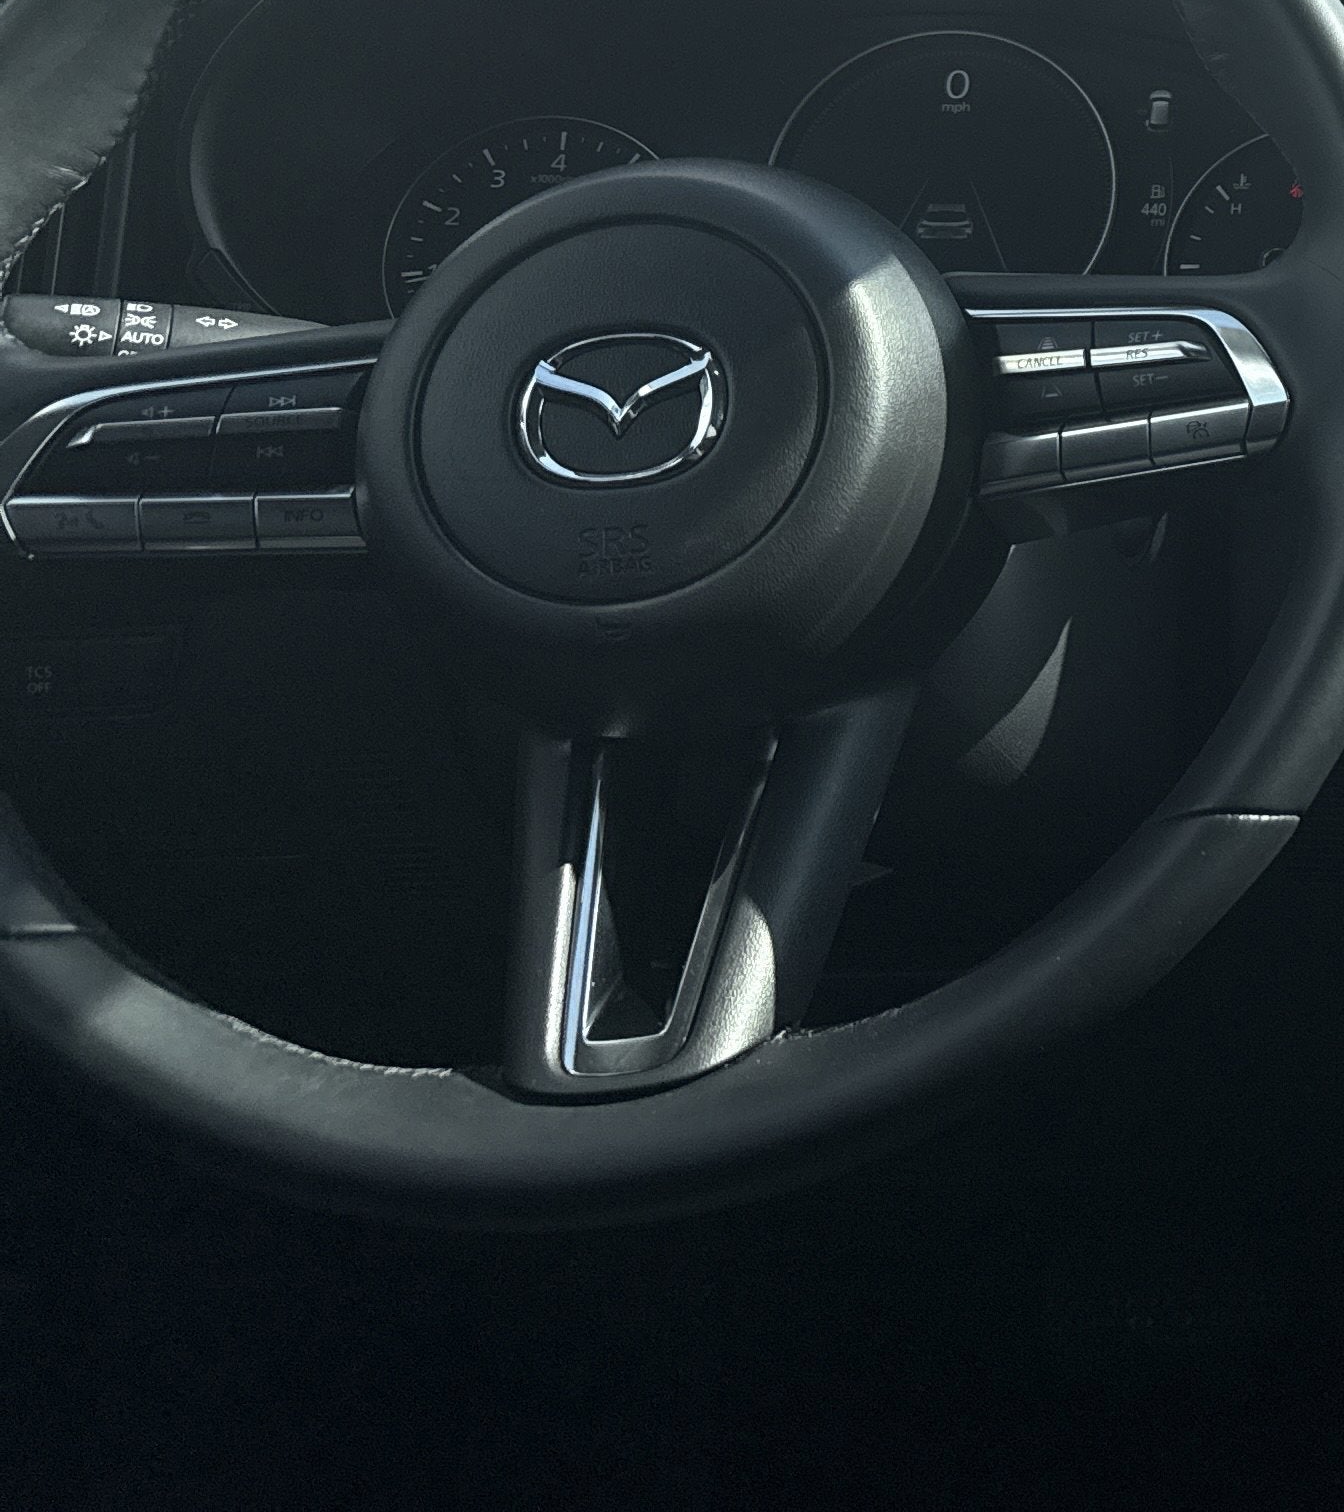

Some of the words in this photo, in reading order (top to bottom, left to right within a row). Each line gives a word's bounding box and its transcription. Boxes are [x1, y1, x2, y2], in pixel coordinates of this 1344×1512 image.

[946, 69, 970, 99] 0
[942, 101, 971, 114] mph
[551, 154, 567, 172] 4
[490, 169, 506, 188] 3
[444, 207, 461, 226] 2
[1141, 202, 1167, 216] 440
[1230, 203, 1242, 215] H
[120, 330, 165, 346] AUTO
[1125, 347, 1149, 360] RES
[284, 508, 324, 522] INFO
[578, 523, 650, 557] SRS
